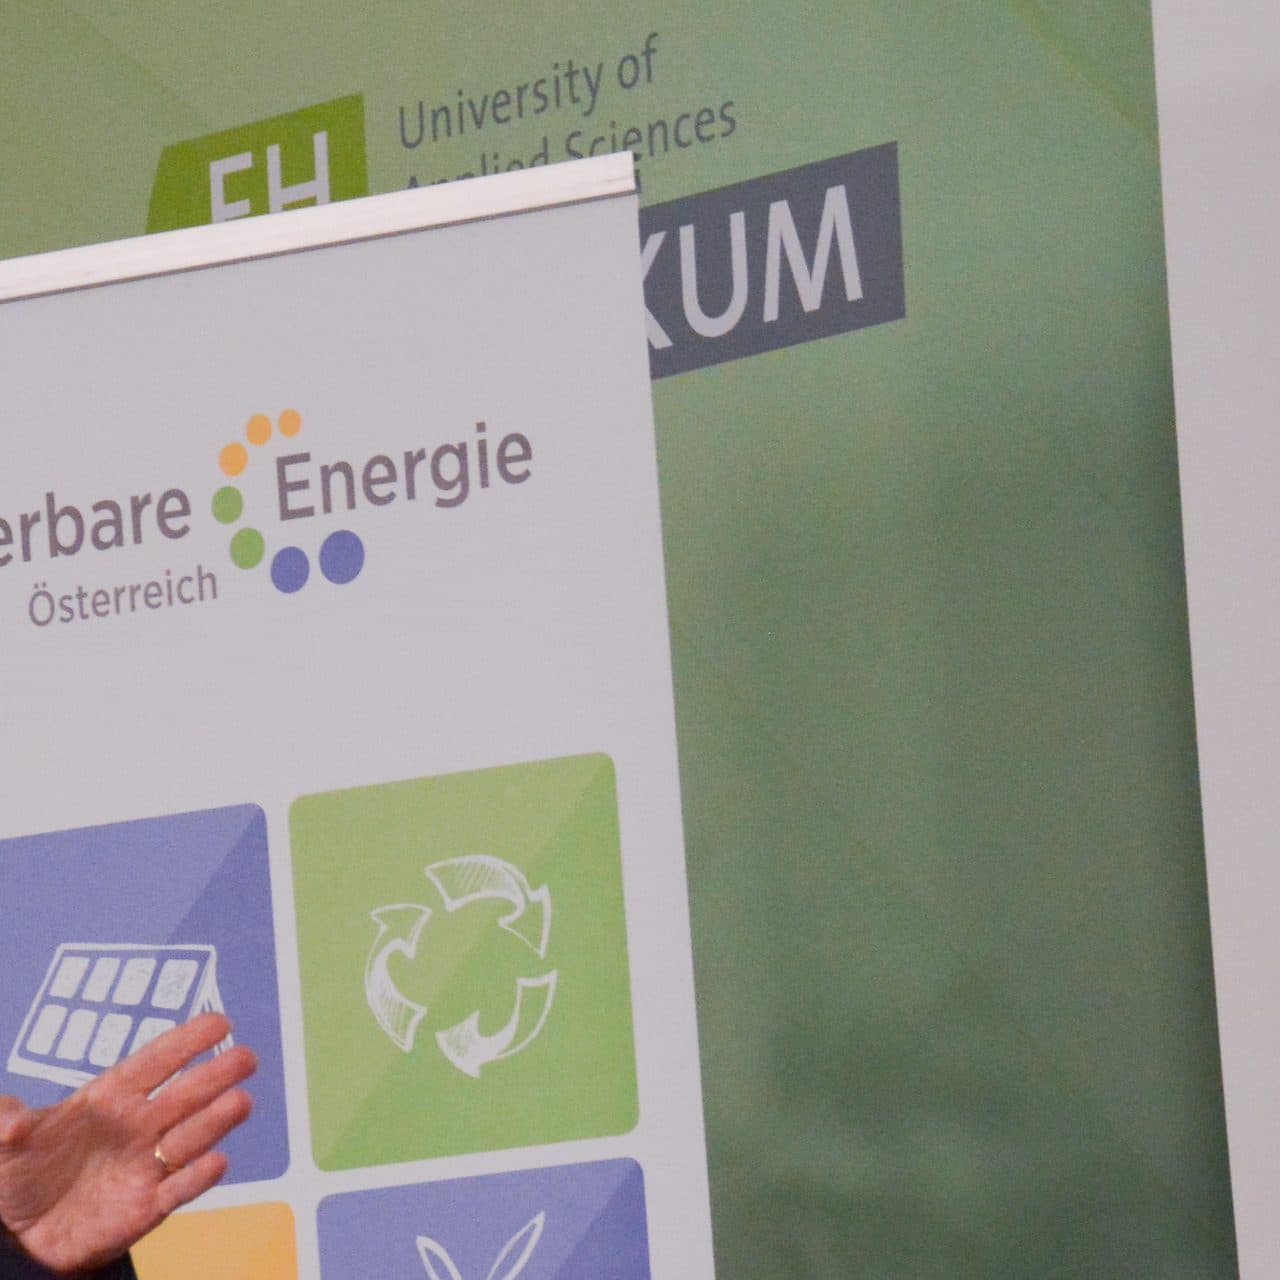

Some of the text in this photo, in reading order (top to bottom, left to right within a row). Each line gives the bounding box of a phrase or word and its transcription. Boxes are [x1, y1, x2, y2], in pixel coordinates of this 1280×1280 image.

[398, 31, 660, 150] University of
[565, 100, 737, 160] Sciences
[275, 421, 534, 522] Energie
[28, 565, 218, 627] Österreich
